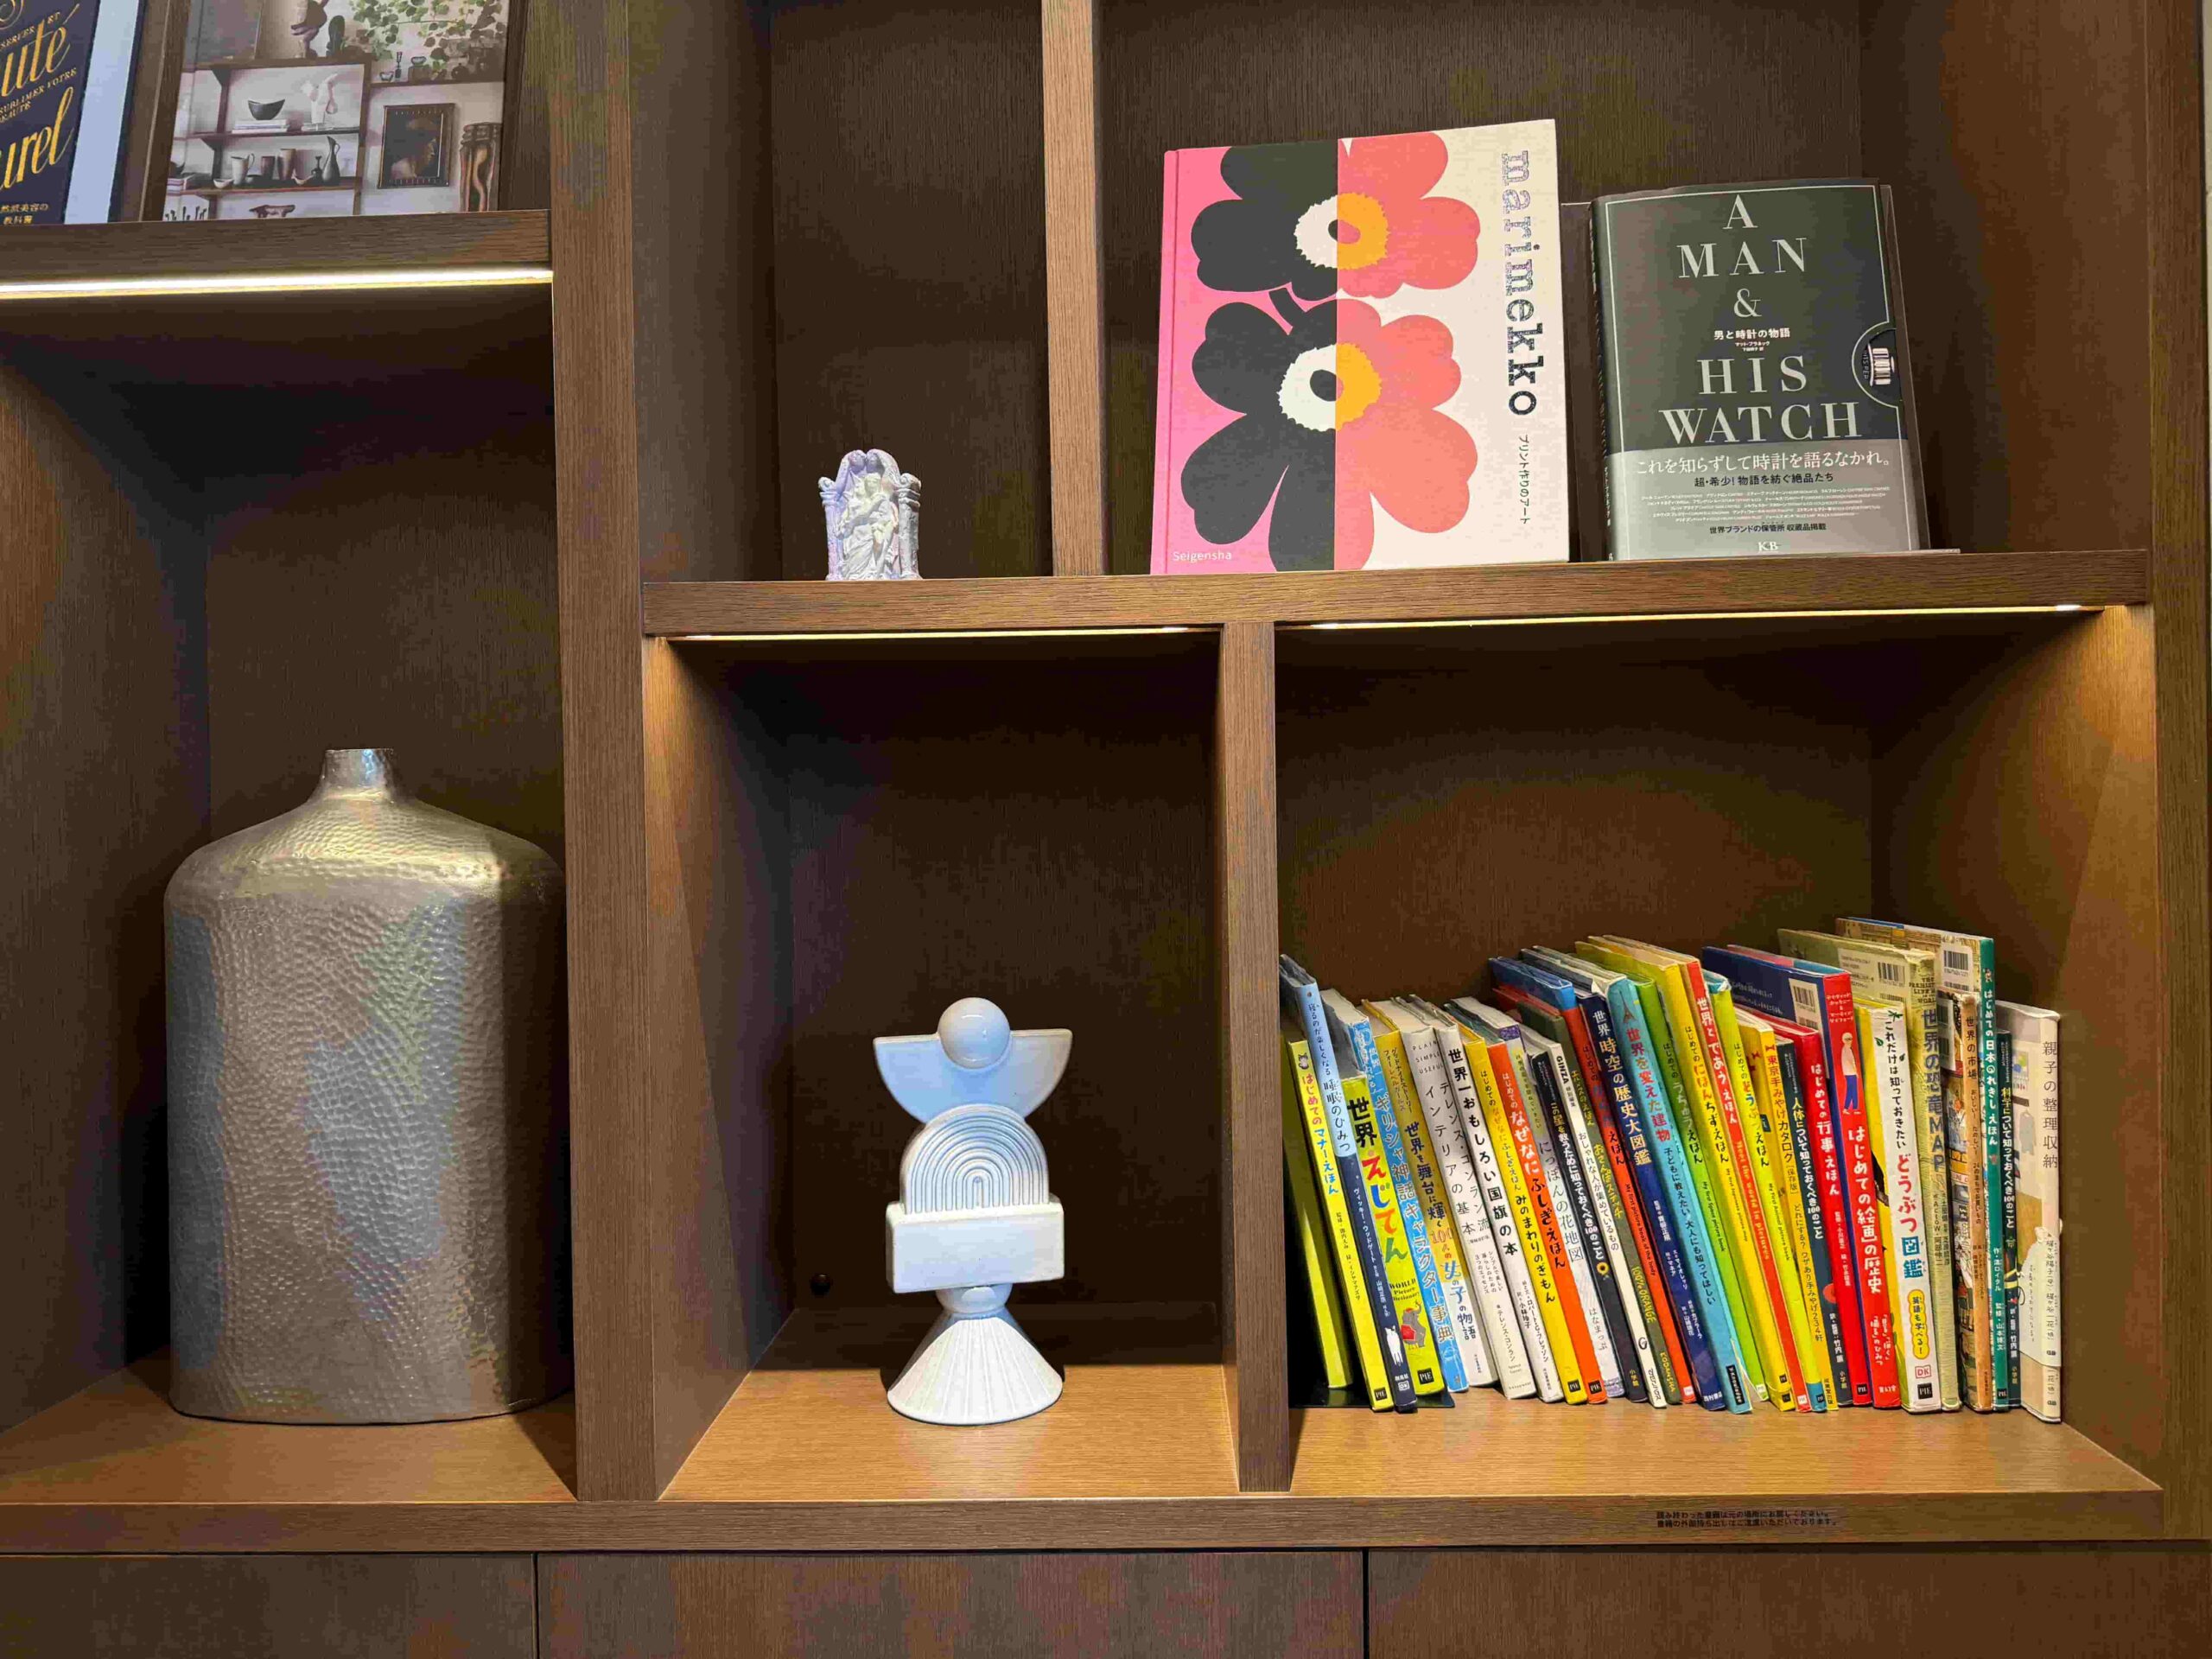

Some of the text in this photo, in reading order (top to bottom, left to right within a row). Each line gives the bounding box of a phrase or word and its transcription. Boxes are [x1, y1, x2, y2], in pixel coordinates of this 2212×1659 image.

[0, 86, 75, 189] urel
[1723, 193, 1759, 230] A
[1676, 237, 1808, 279] MAN
[1501, 149, 1545, 416] marimekko
[1733, 288, 1763, 318] &
[1713, 327, 1791, 340] 男と時計の物語
[1696, 355, 1808, 395] HIS
[1657, 401, 1863, 445] WATCH
[1636, 450, 1891, 474] これを知らずして時計を語るなかれ。
[1517, 434, 1530, 524] プリント作りのアート
[1172, 549, 1233, 563] Seigensha
[1412, 1039, 1439, 1052] PLAIN
[1415, 1051, 1441, 1064] SIMPLE
[1965, 1015, 1978, 1080] 世界の市場
[1418, 1063, 1444, 1075] USEFUL
[1556, 1056, 1570, 1084] GINZA
[1625, 1027, 1672, 1142] 世界を変えた建物
[2042, 1040, 2058, 1169] 親子の整理収納
[1447, 1047, 1519, 1256] 世界一おもしろい国旗の本
[1420, 1372, 1433, 1382] PIE
[1916, 1367, 1931, 1376] DK
[1918, 1386, 1933, 1396] PIE
